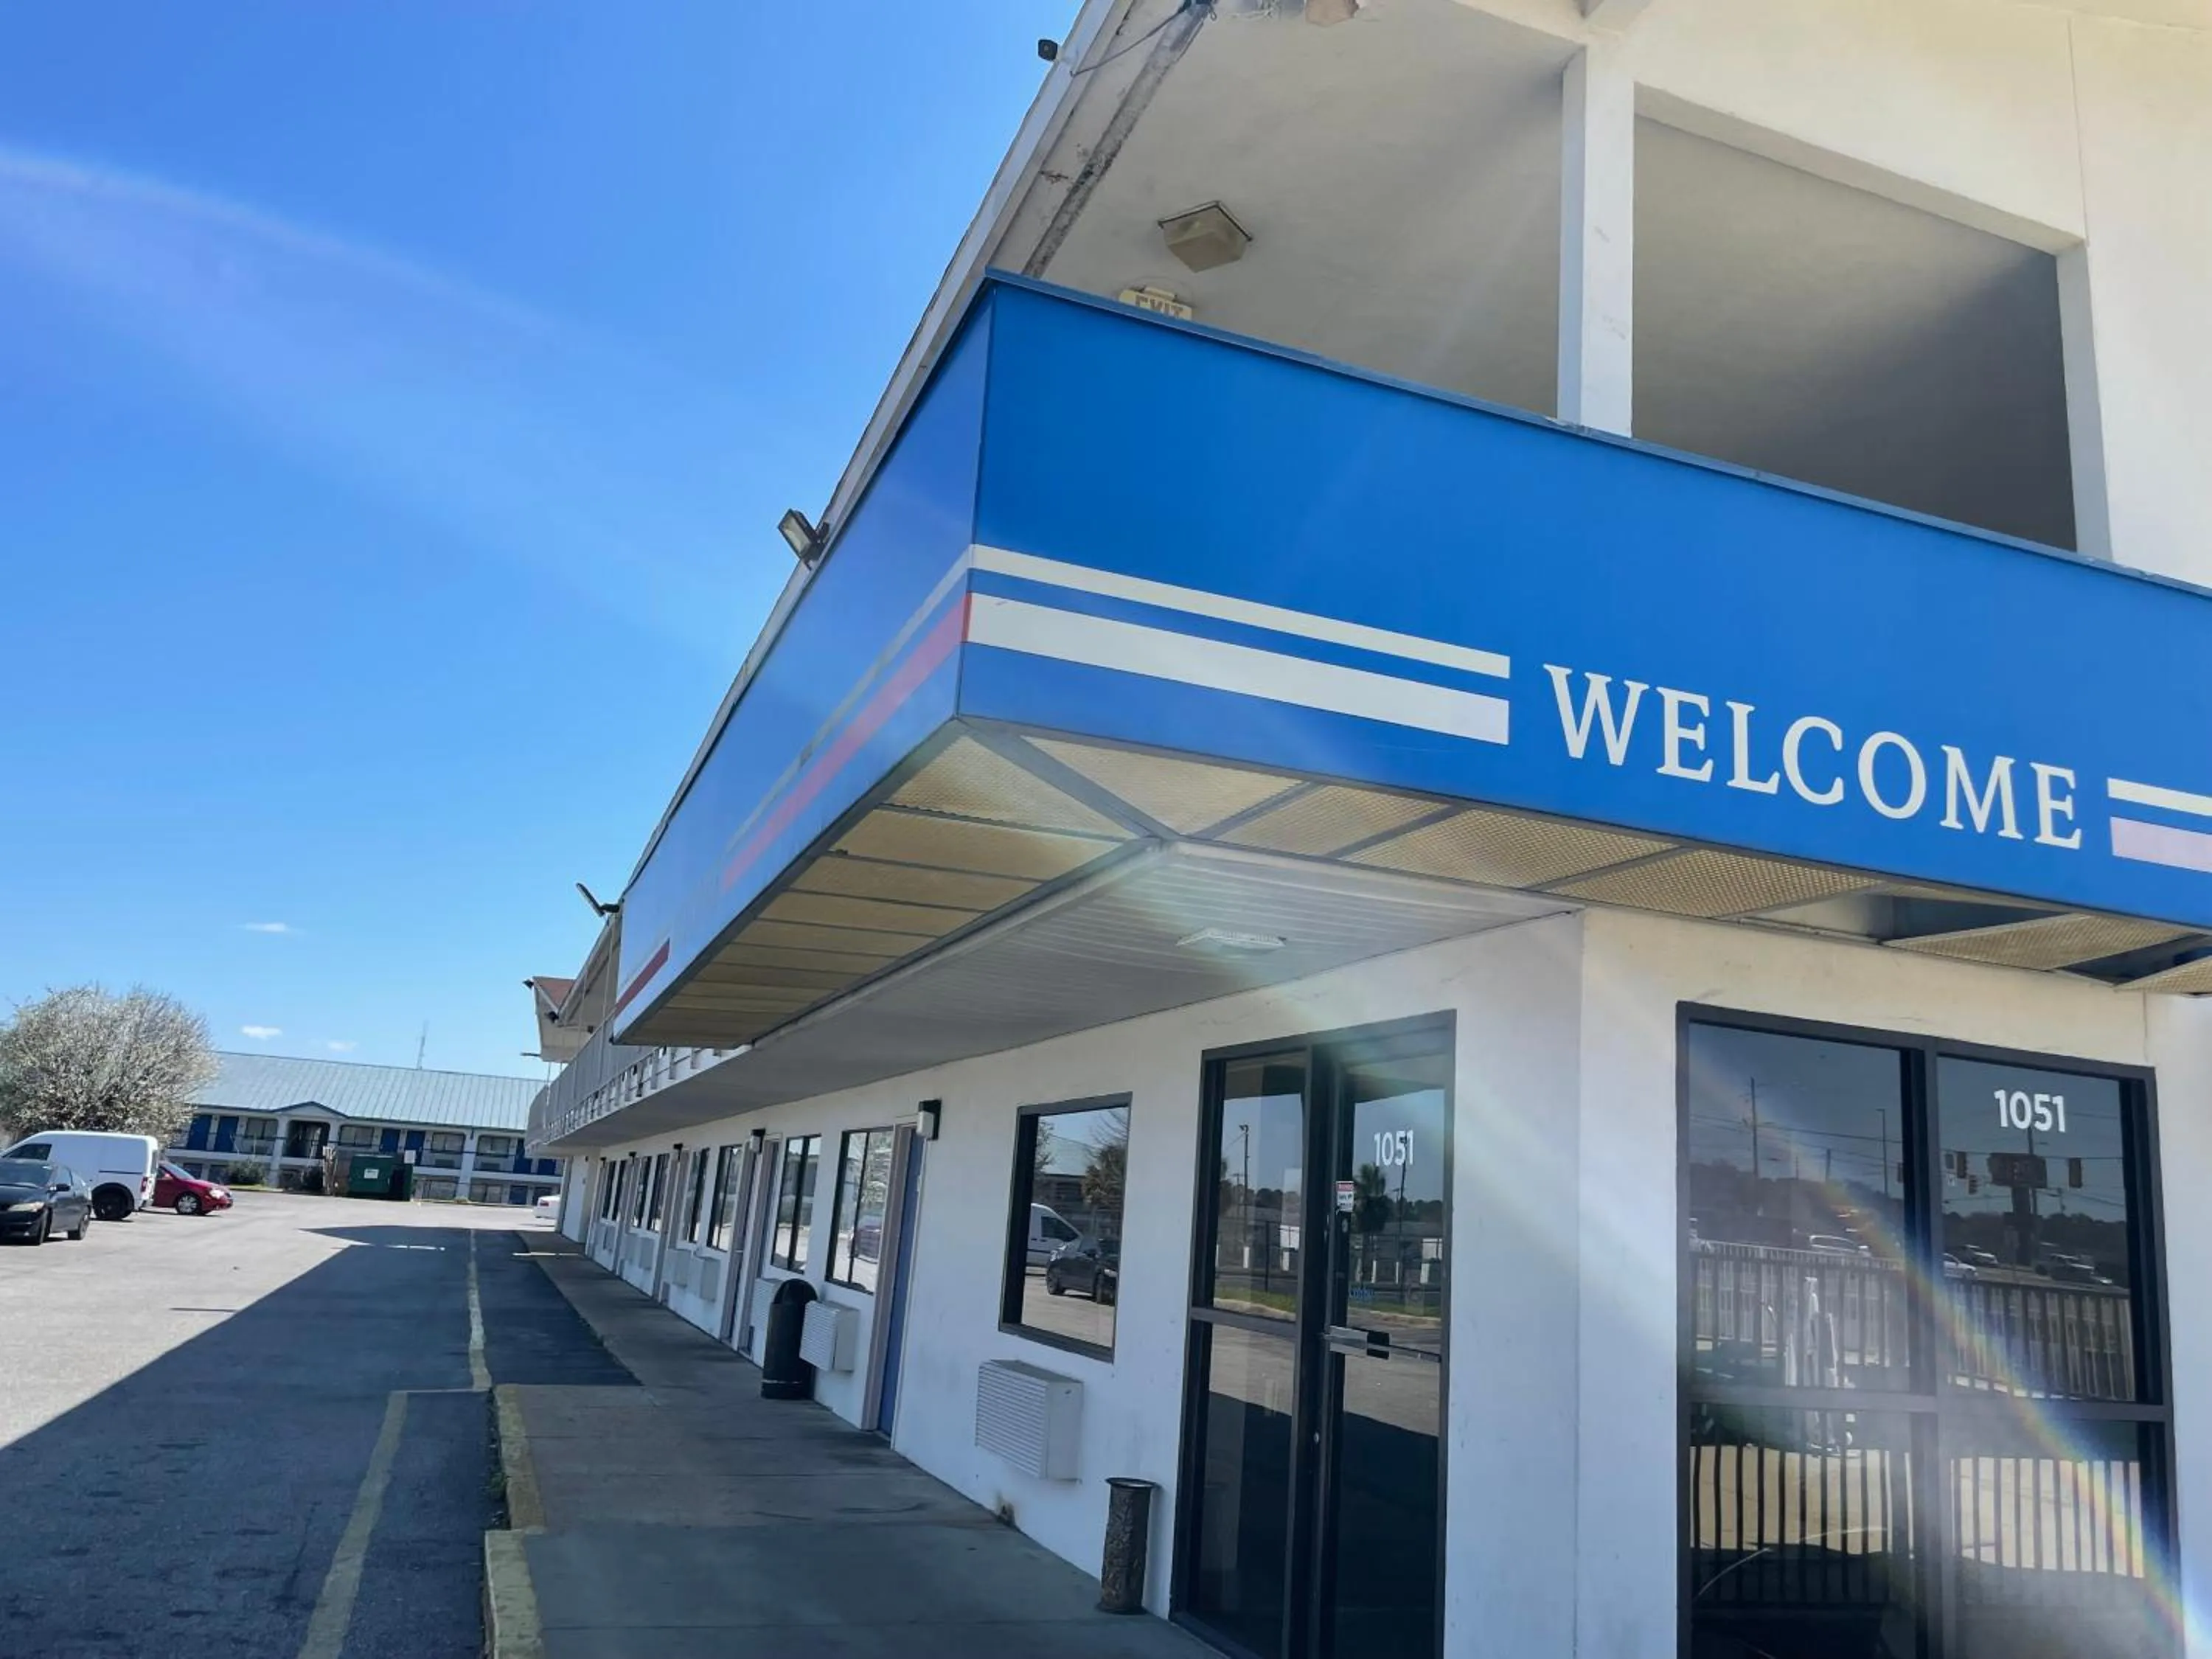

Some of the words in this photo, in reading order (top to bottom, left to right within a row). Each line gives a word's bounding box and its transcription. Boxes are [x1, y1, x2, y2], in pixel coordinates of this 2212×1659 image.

[1543, 663, 2083, 850] WELCOME
[1993, 1089, 2066, 1133] 1051
[1374, 1129, 1414, 1166] 1051
